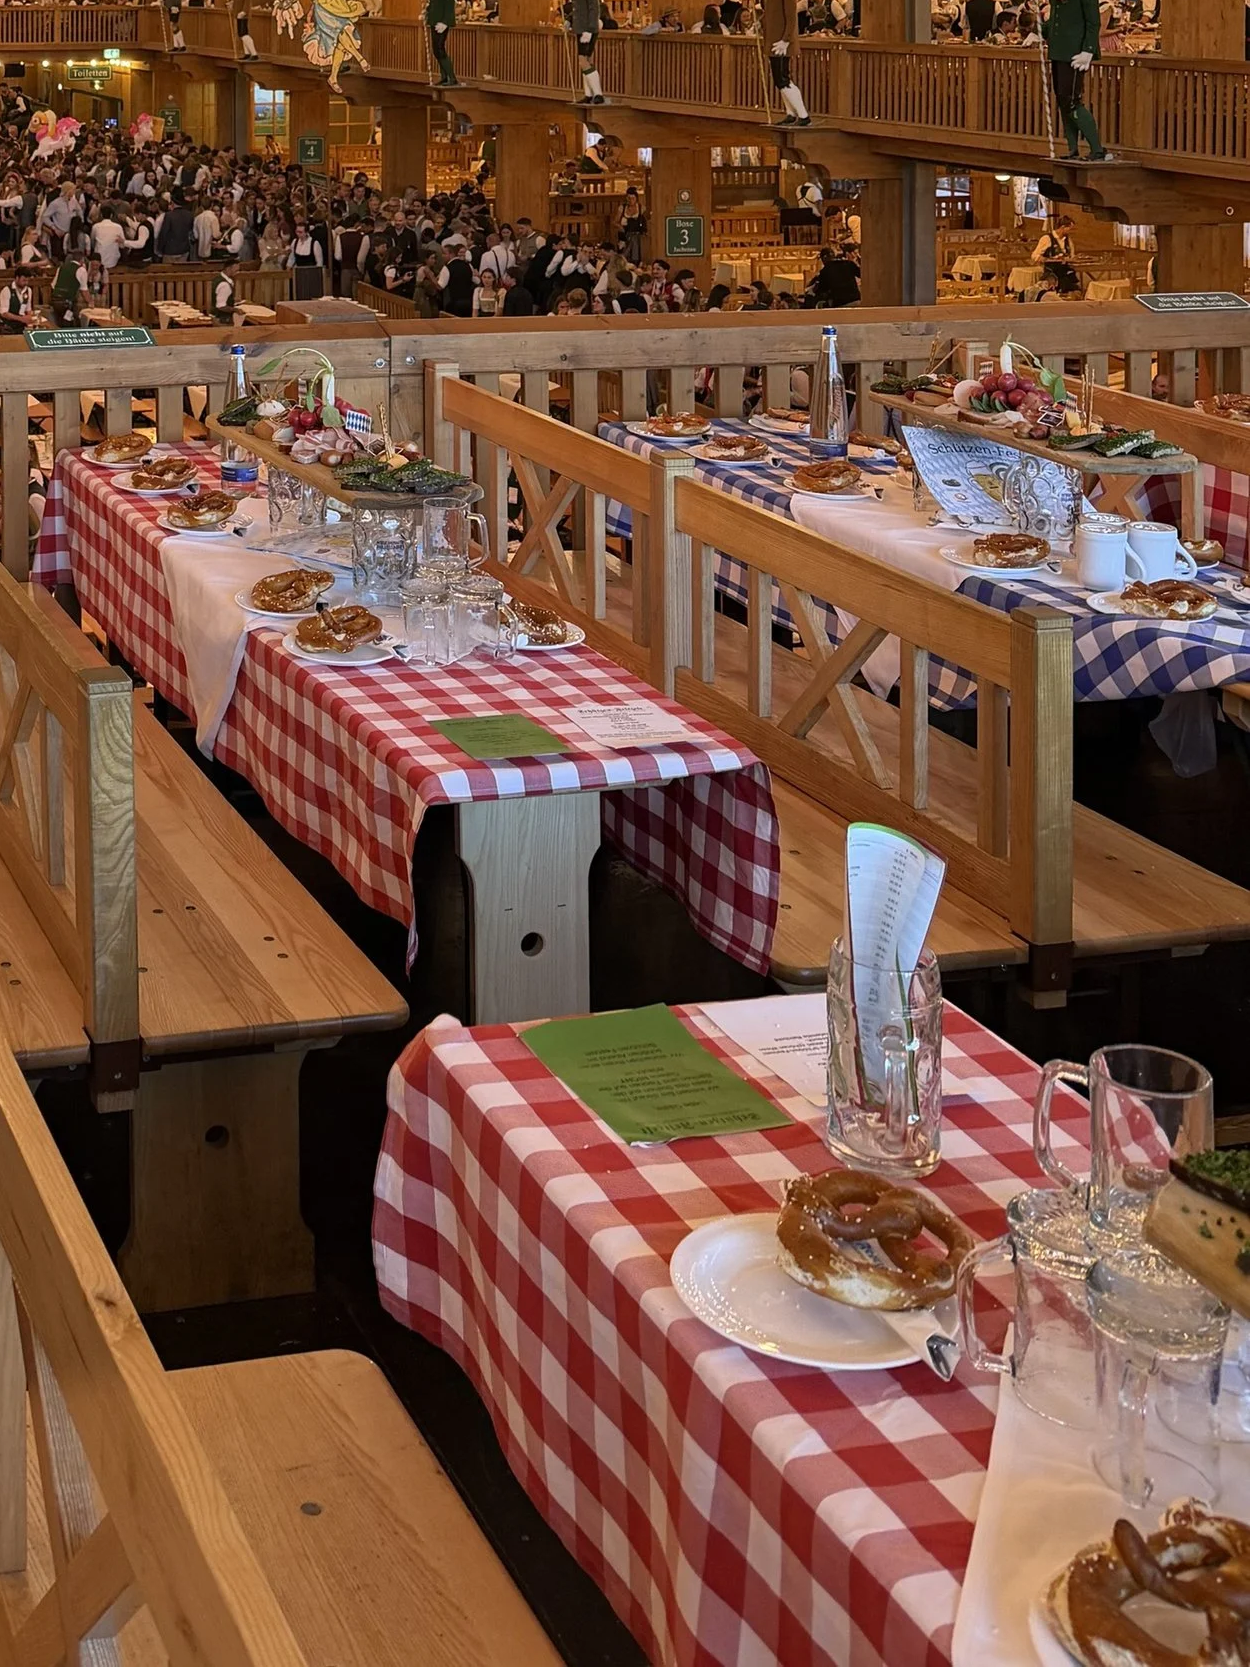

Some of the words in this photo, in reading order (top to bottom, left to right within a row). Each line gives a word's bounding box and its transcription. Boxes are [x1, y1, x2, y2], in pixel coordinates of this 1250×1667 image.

[73, 69, 108, 77] Toiletten
[307, 145, 315, 157] 4
[680, 229, 690, 245] 3
